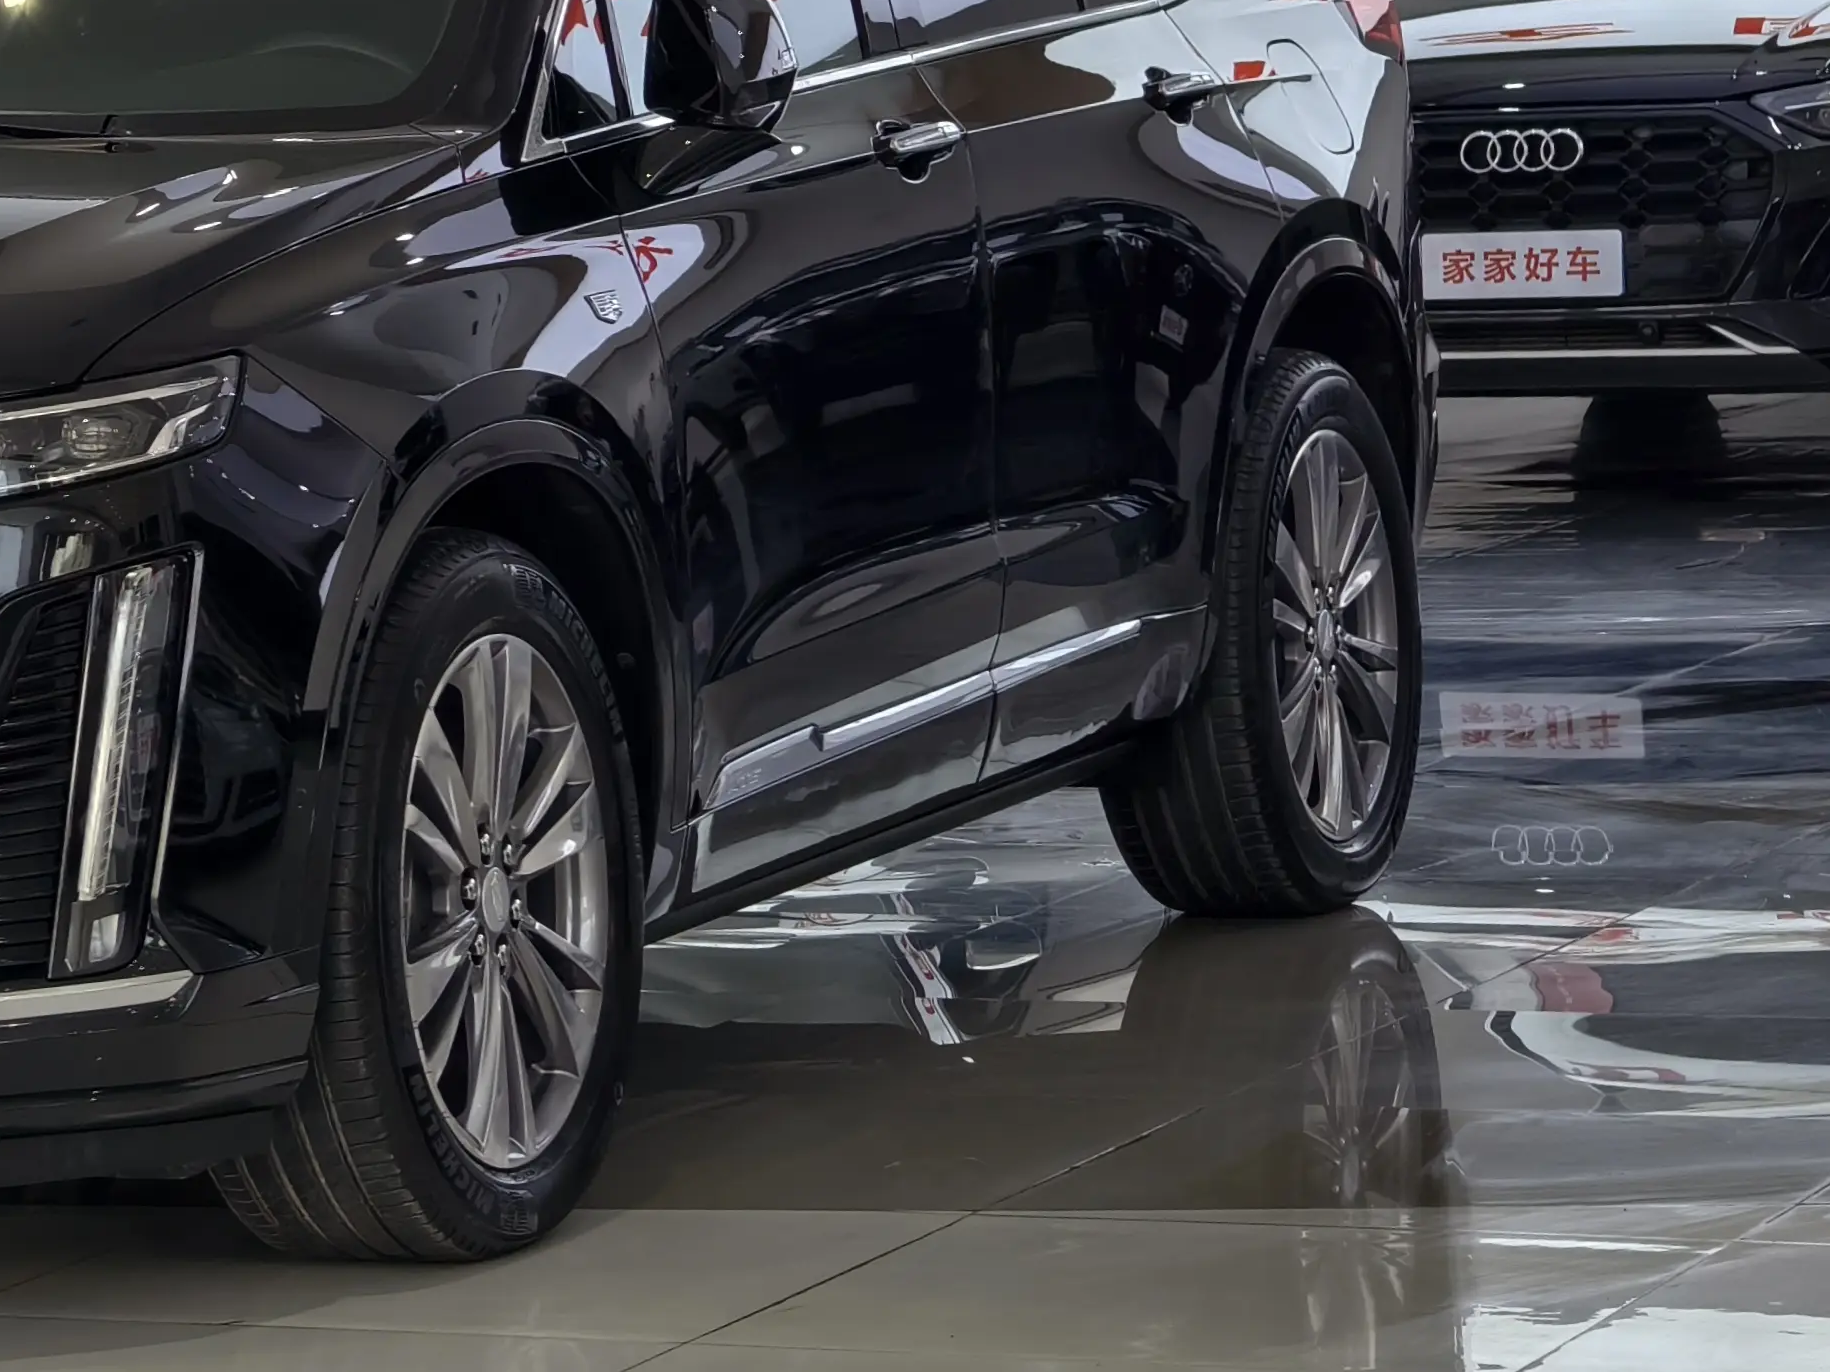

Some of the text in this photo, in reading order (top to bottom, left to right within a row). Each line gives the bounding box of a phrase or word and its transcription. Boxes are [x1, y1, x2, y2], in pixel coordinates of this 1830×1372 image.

[1442, 246, 1600, 284] 家家好车
[407, 1072, 496, 1216] MICHELIN
